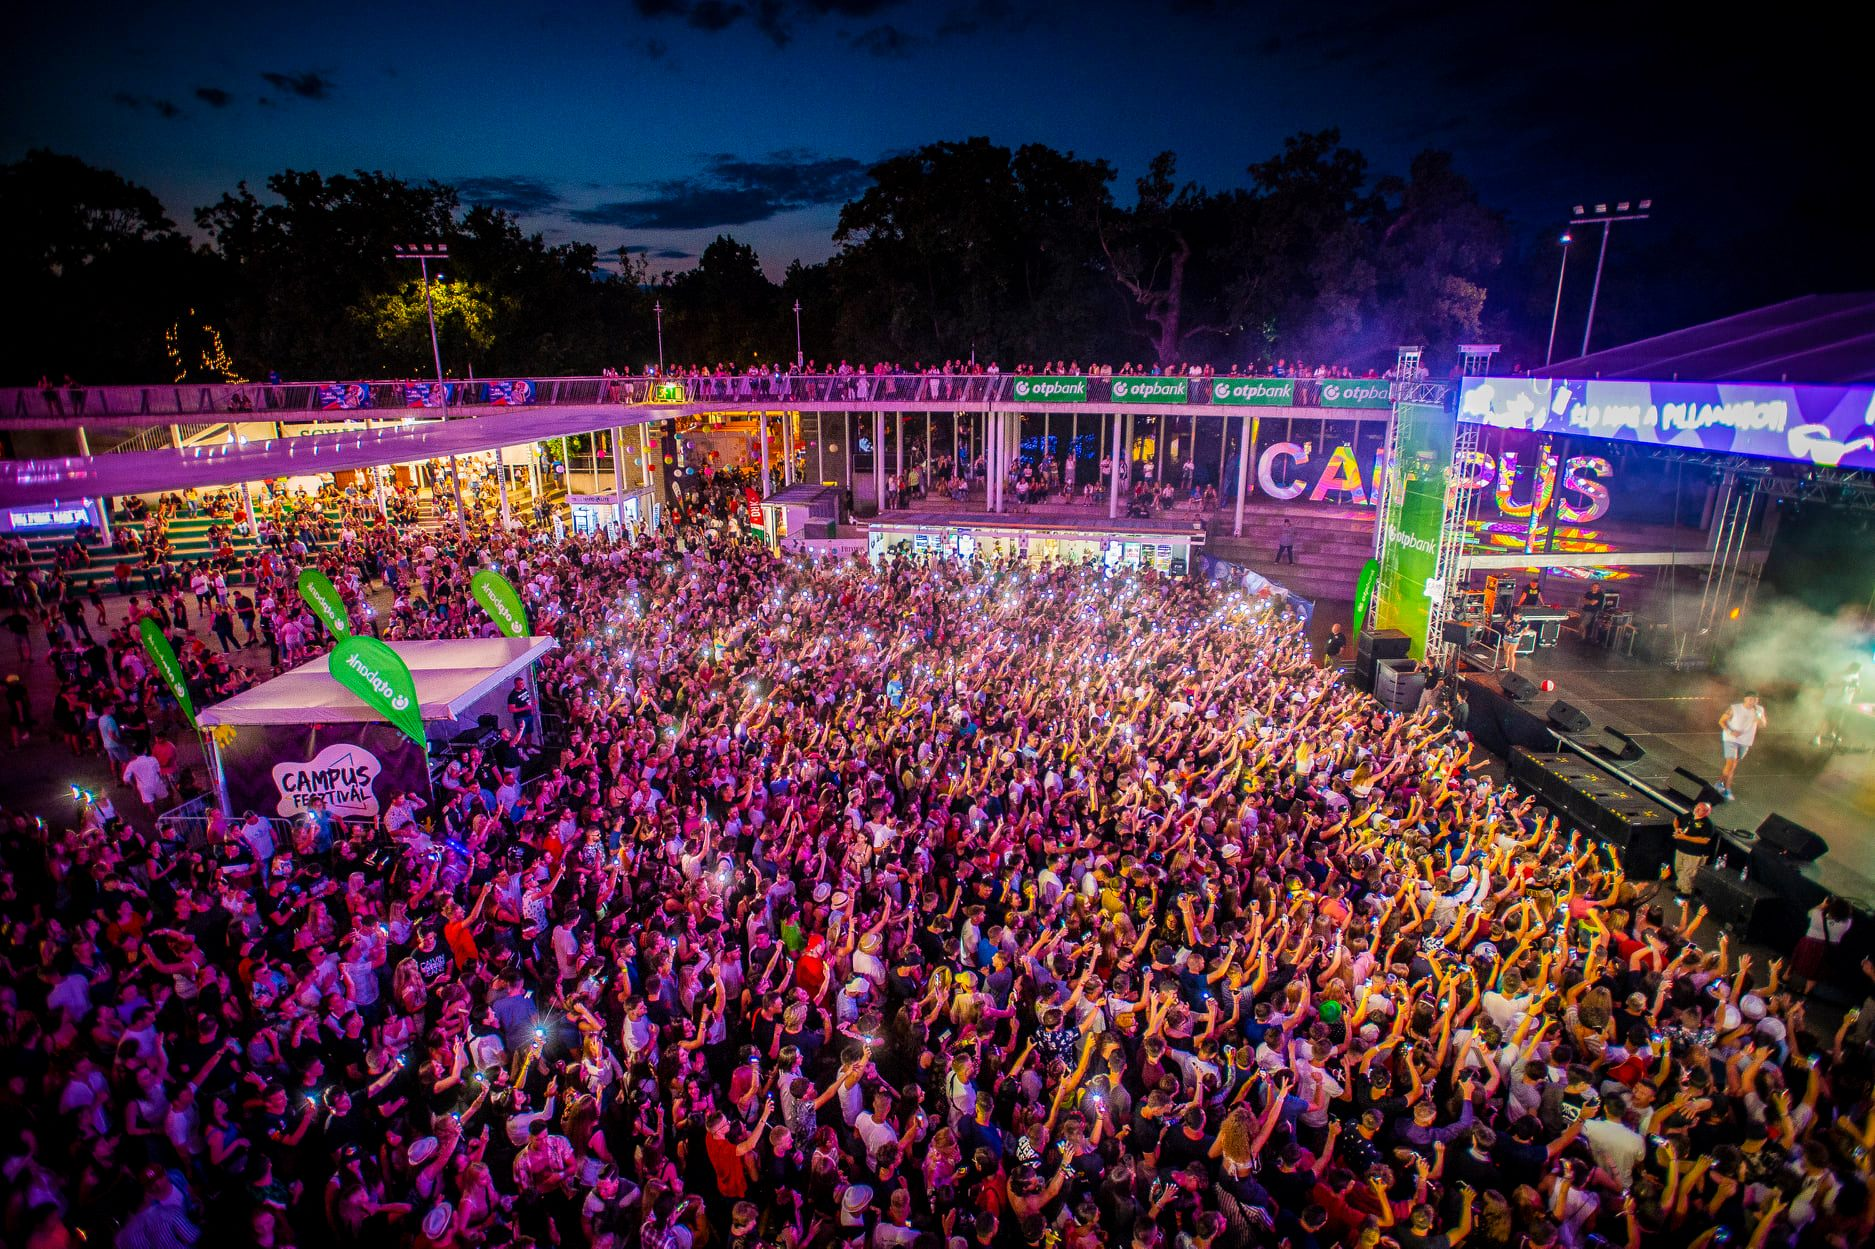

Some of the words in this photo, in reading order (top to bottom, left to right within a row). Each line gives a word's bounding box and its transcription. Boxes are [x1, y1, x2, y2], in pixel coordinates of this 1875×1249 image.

[1032, 381, 1085, 397] otpbank
[1130, 381, 1186, 398] otpbank
[1233, 384, 1292, 400] otpbank
[1343, 386, 1390, 403] otpba
[1396, 529, 1437, 555] otpbank
[282, 766, 371, 793] CAMPUS
